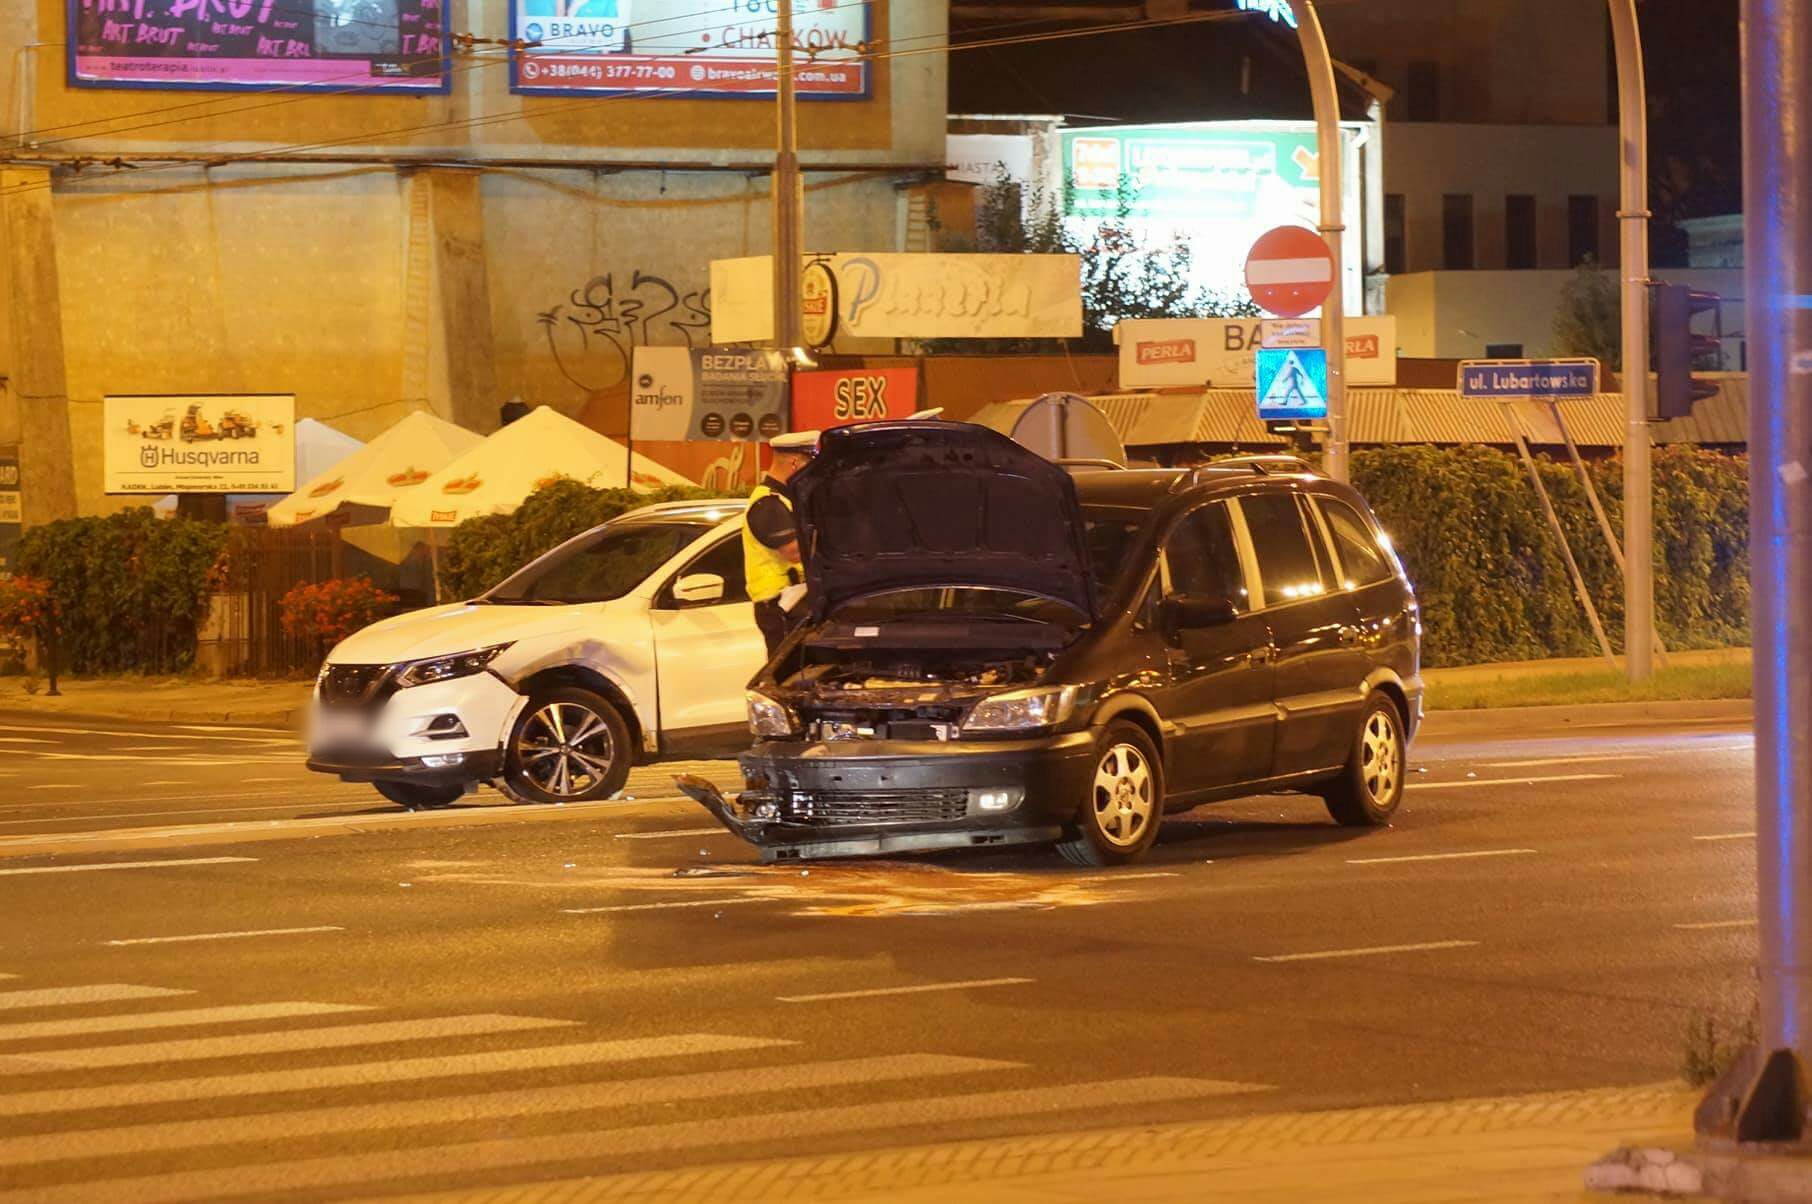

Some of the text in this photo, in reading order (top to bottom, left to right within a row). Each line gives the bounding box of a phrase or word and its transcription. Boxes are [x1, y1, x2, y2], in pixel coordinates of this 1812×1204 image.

[102, 19, 185, 45] ART BRUT
[550, 22, 615, 38] BRAVO
[722, 23, 848, 50] CHAKÓW
[606, 66, 676, 79] 377-77-00
[707, 68, 847, 83] bravoairwa.com.ua
[1224, 324, 1262, 351] BA
[702, 354, 788, 371] BEZPŁA
[1469, 370, 1589, 390] ul. Lubartowska
[635, 385, 683, 411] amfon
[834, 376, 887, 419] SEX
[161, 448, 260, 467] Husqvarna
